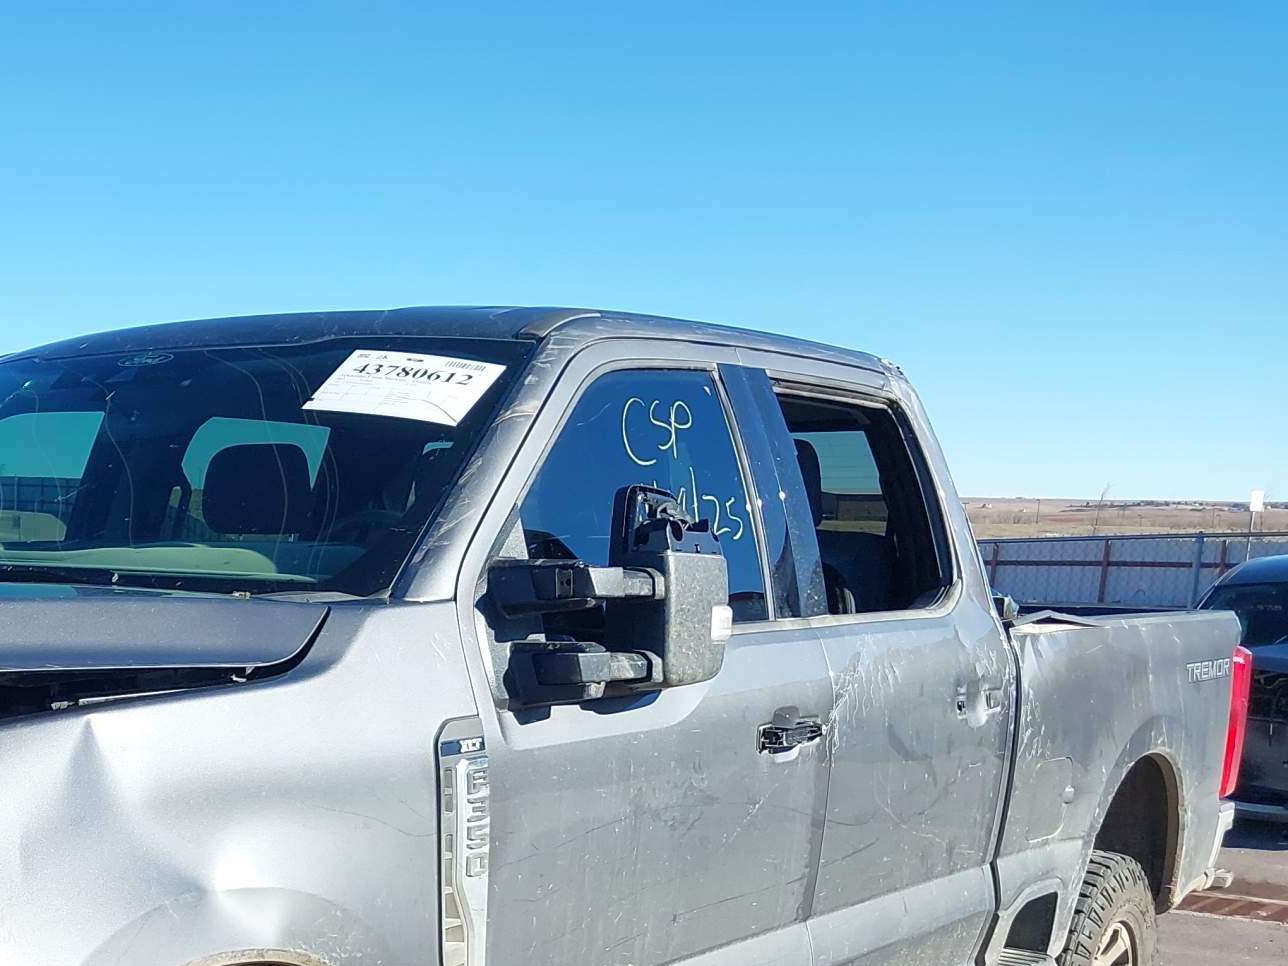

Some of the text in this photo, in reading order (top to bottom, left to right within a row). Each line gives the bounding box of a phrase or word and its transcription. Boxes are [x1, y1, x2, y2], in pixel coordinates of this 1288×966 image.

[353, 362, 473, 386] 43780612
[621, 396, 694, 466] CSP
[1186, 657, 1231, 684] TREMOR
[458, 737, 483, 754] XLT
